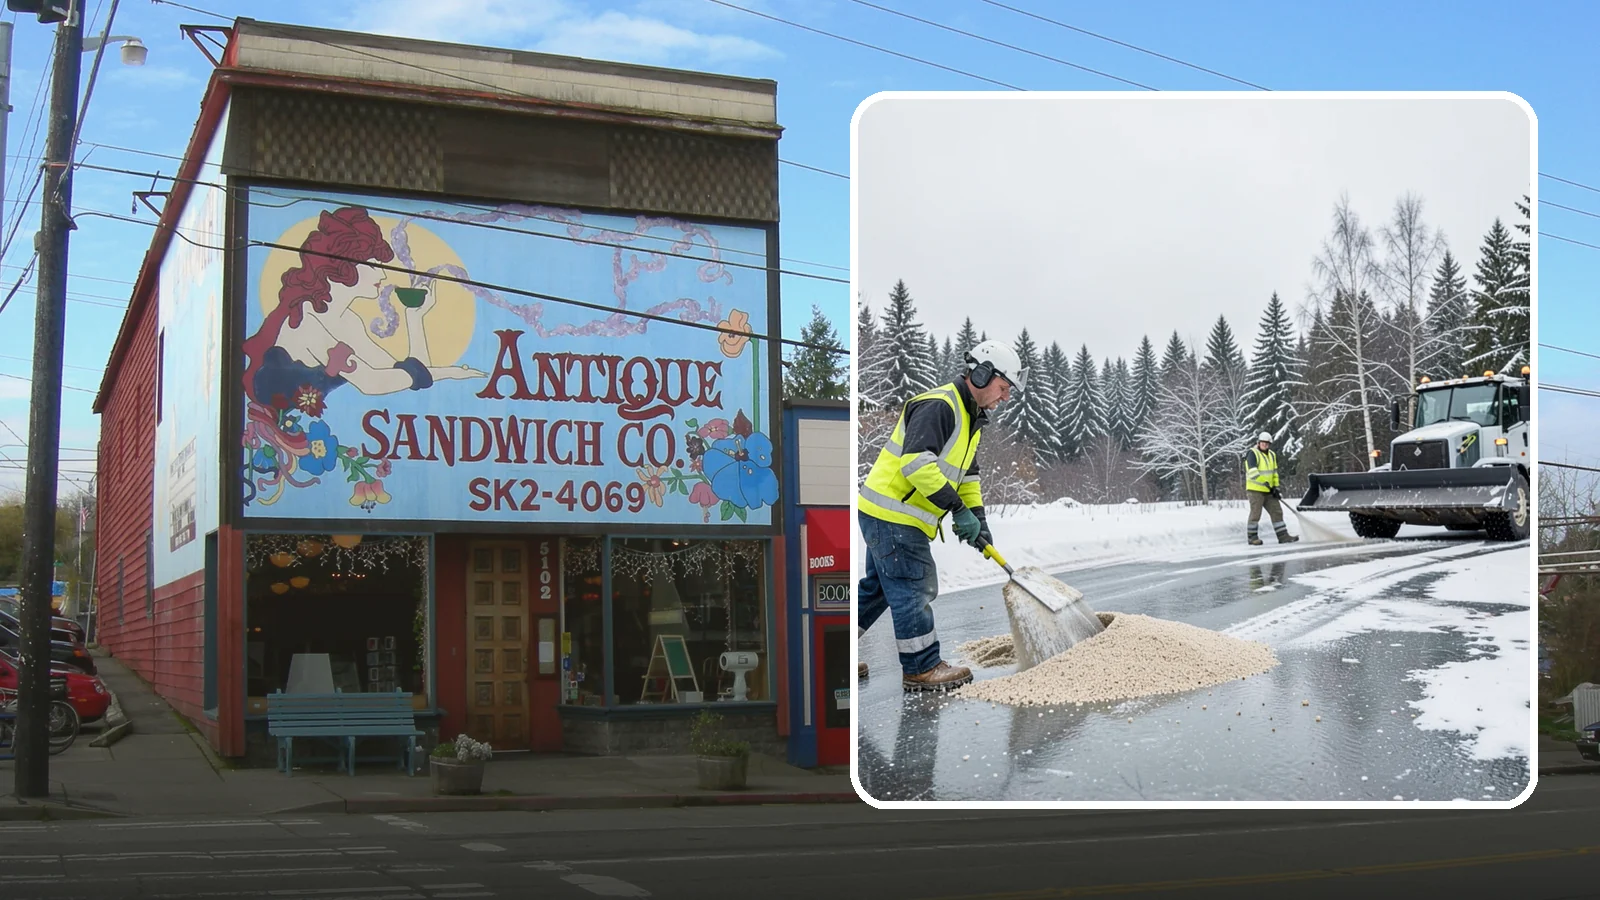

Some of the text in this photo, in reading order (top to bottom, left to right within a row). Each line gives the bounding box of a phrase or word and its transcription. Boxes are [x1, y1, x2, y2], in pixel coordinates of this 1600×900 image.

[476, 329, 724, 421] ANTIQUE
[361, 408, 685, 469] SANDWICH CO.
[468, 477, 644, 513] SK2-4069
[540, 541, 551, 599] 5102
[809, 555, 835, 568] BOOKS
